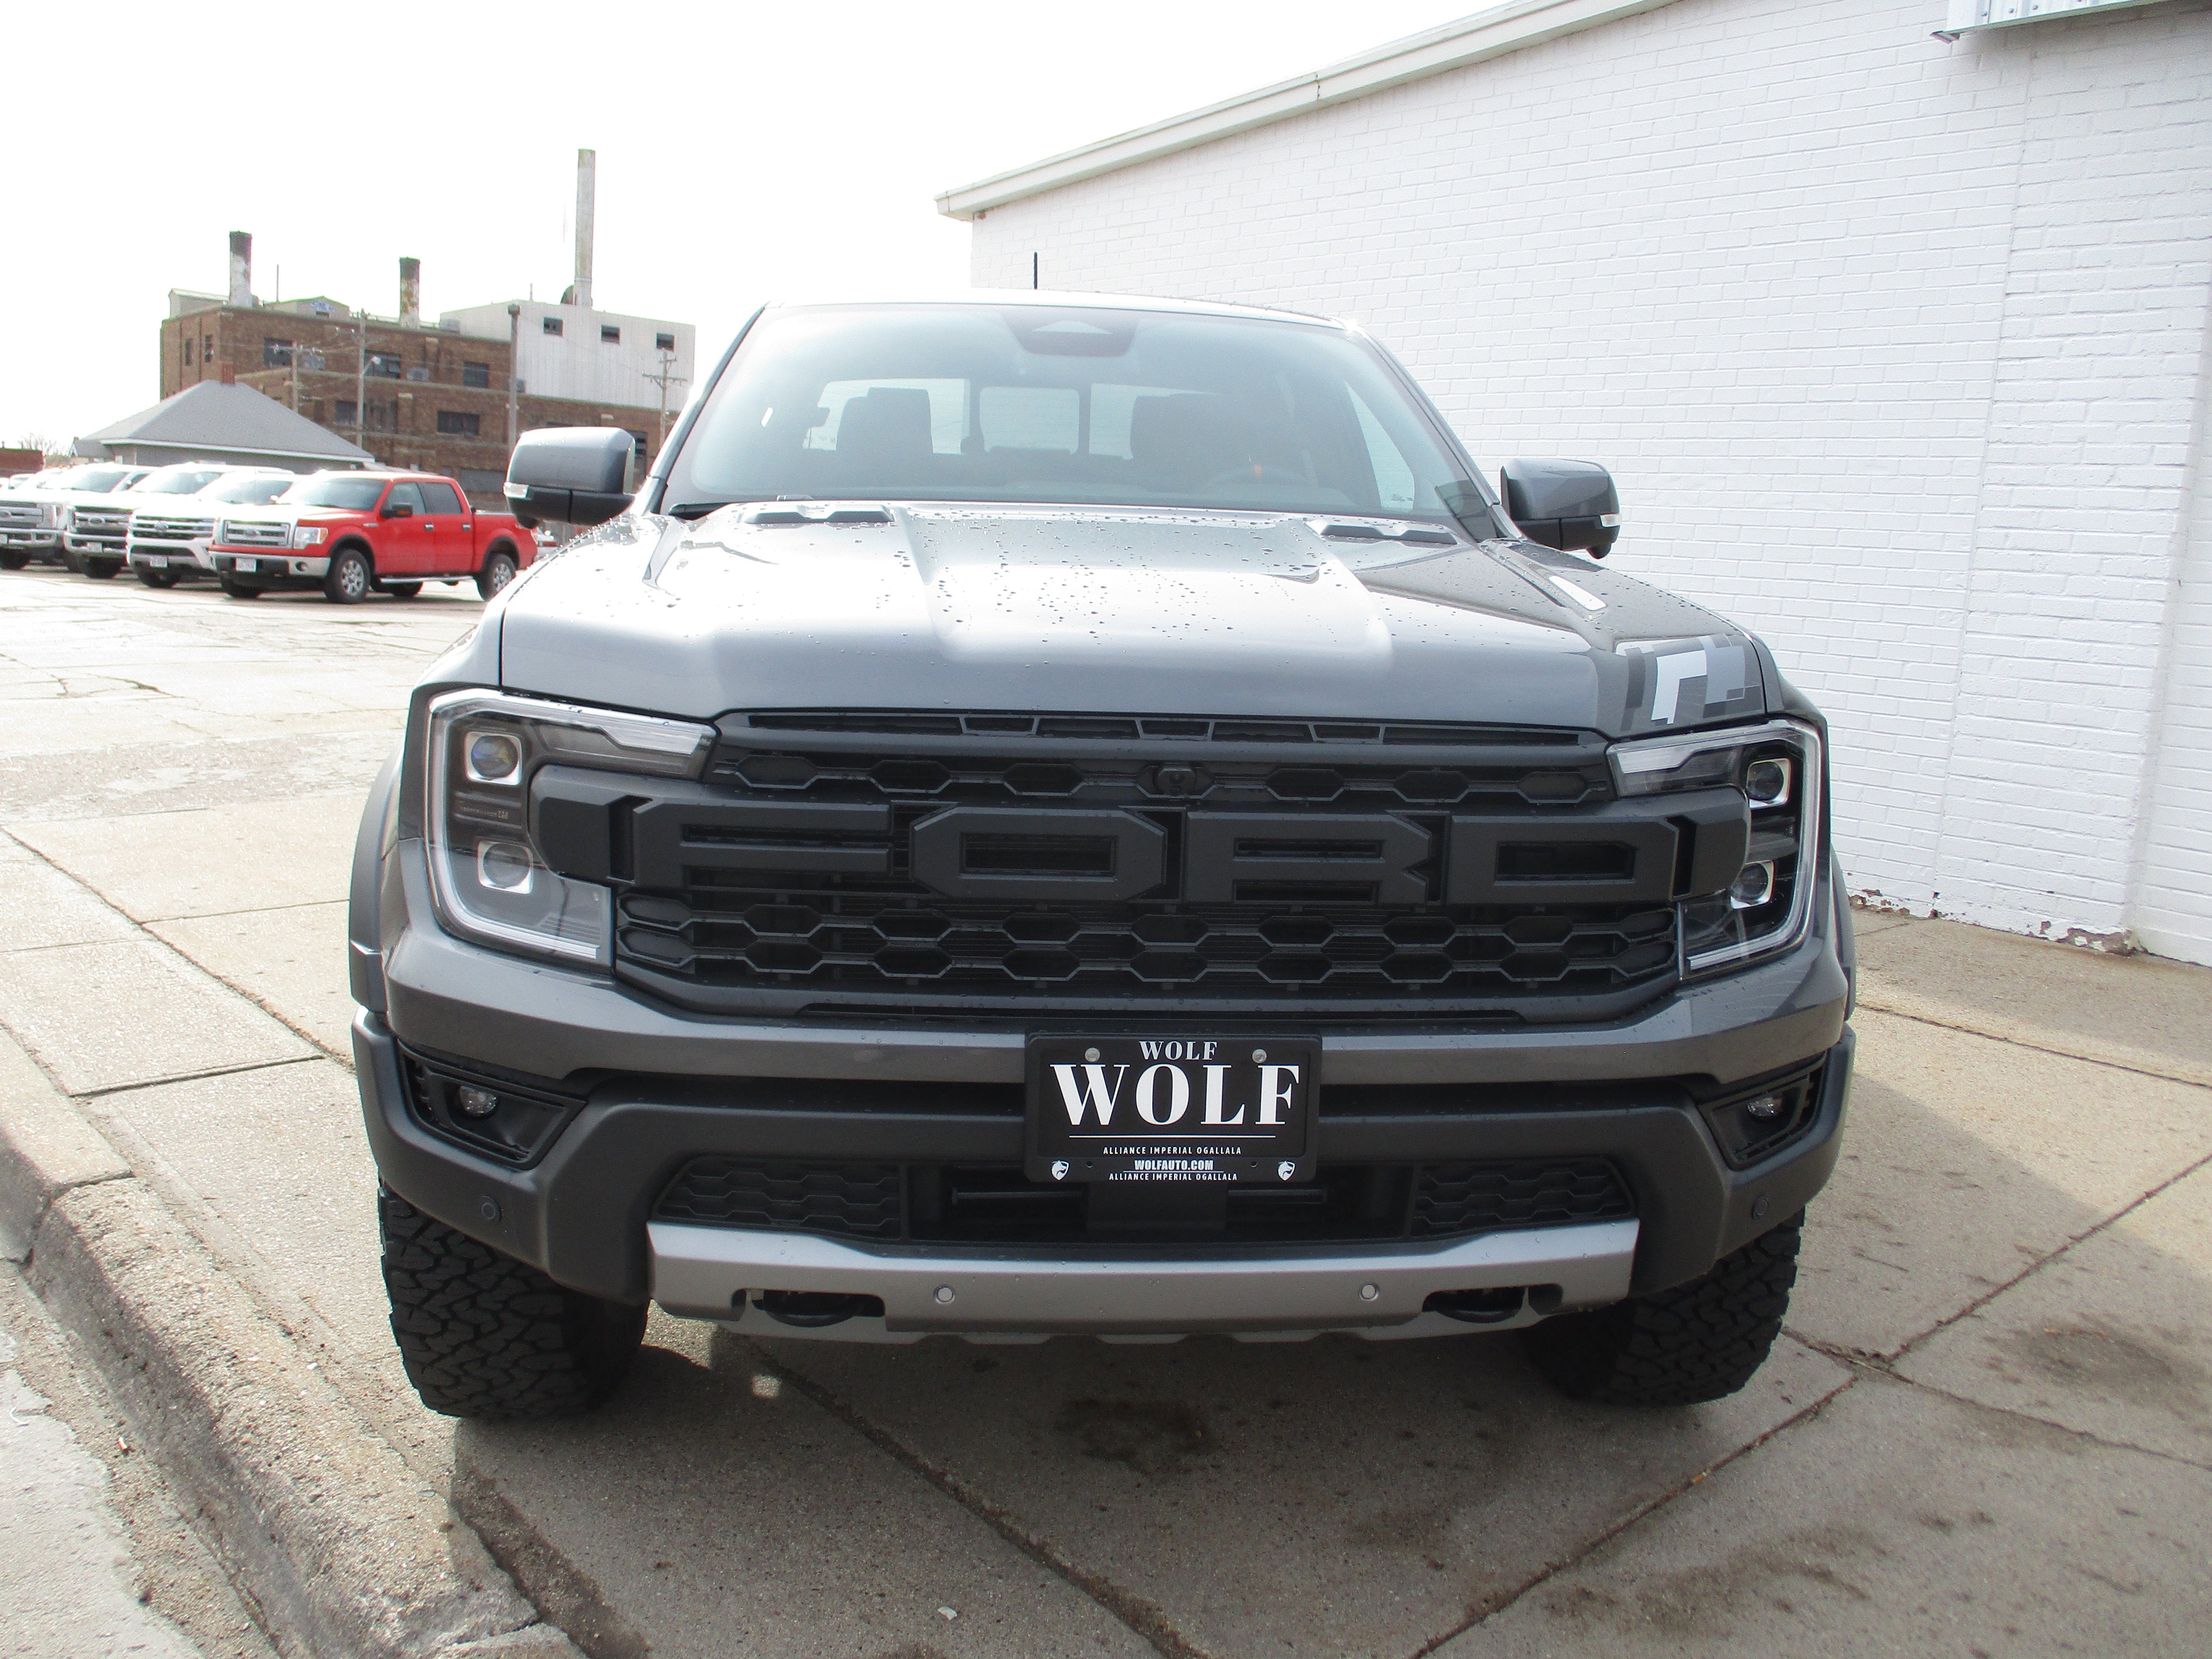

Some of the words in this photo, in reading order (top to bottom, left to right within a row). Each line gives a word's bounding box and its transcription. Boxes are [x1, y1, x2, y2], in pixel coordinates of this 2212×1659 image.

[633, 802, 1679, 904] FORD
[1139, 1041, 1217, 1060] WOLF
[1050, 1064, 1299, 1125] WOLF
[1134, 1160, 1213, 1170] WOLFAUTO.COM
